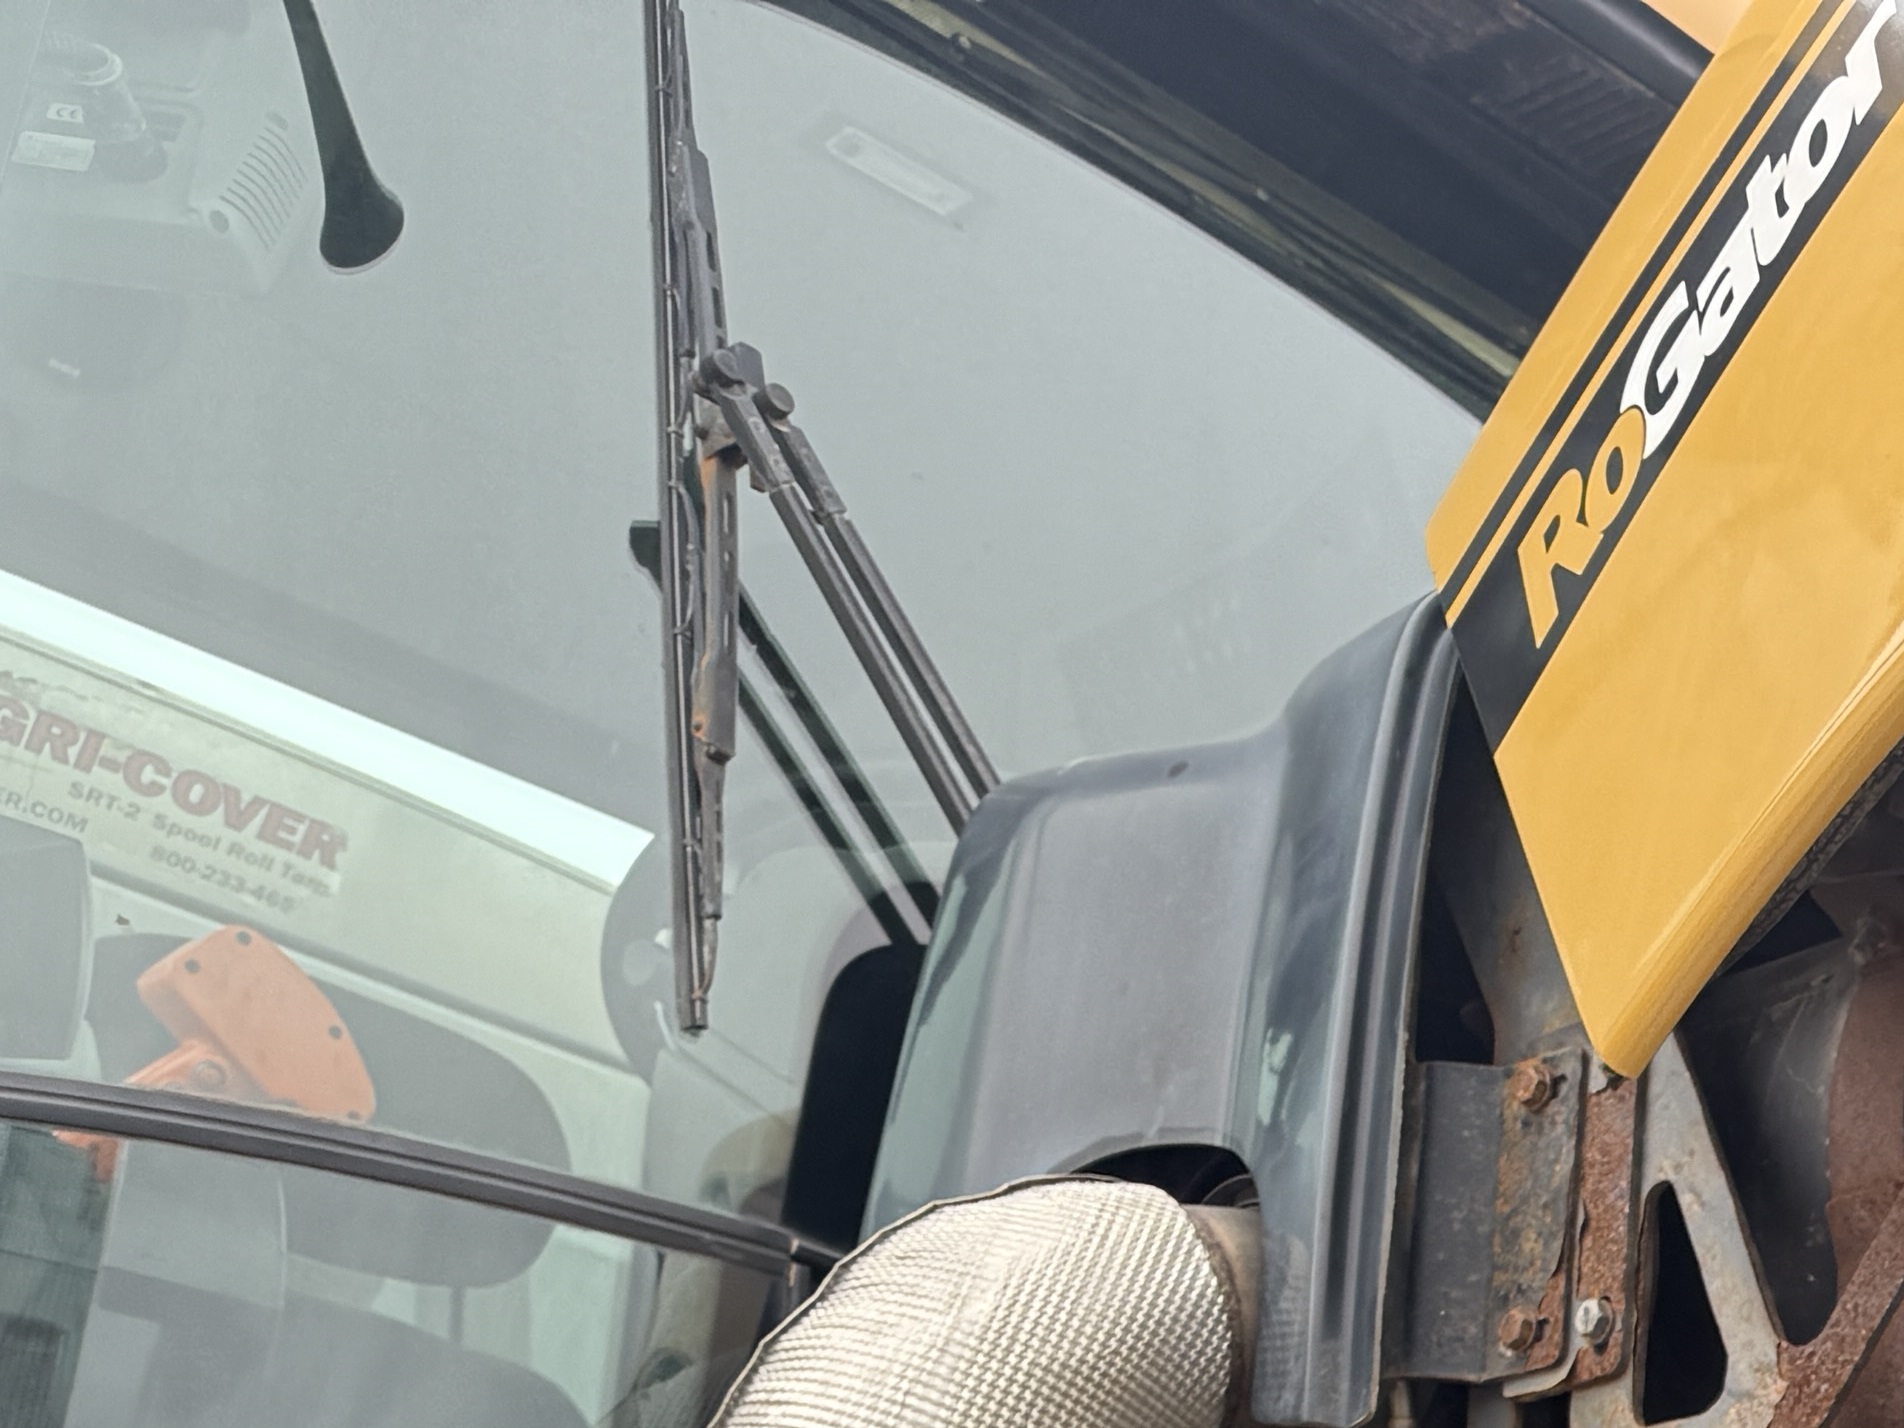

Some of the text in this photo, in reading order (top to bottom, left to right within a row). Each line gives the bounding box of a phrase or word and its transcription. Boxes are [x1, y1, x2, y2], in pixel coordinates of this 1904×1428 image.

[1517, 0, 1898, 649] RoGator
[67, 781, 143, 822] SRT-2
[151, 812, 224, 852] Spool
[226, 841, 276, 872] Roll
